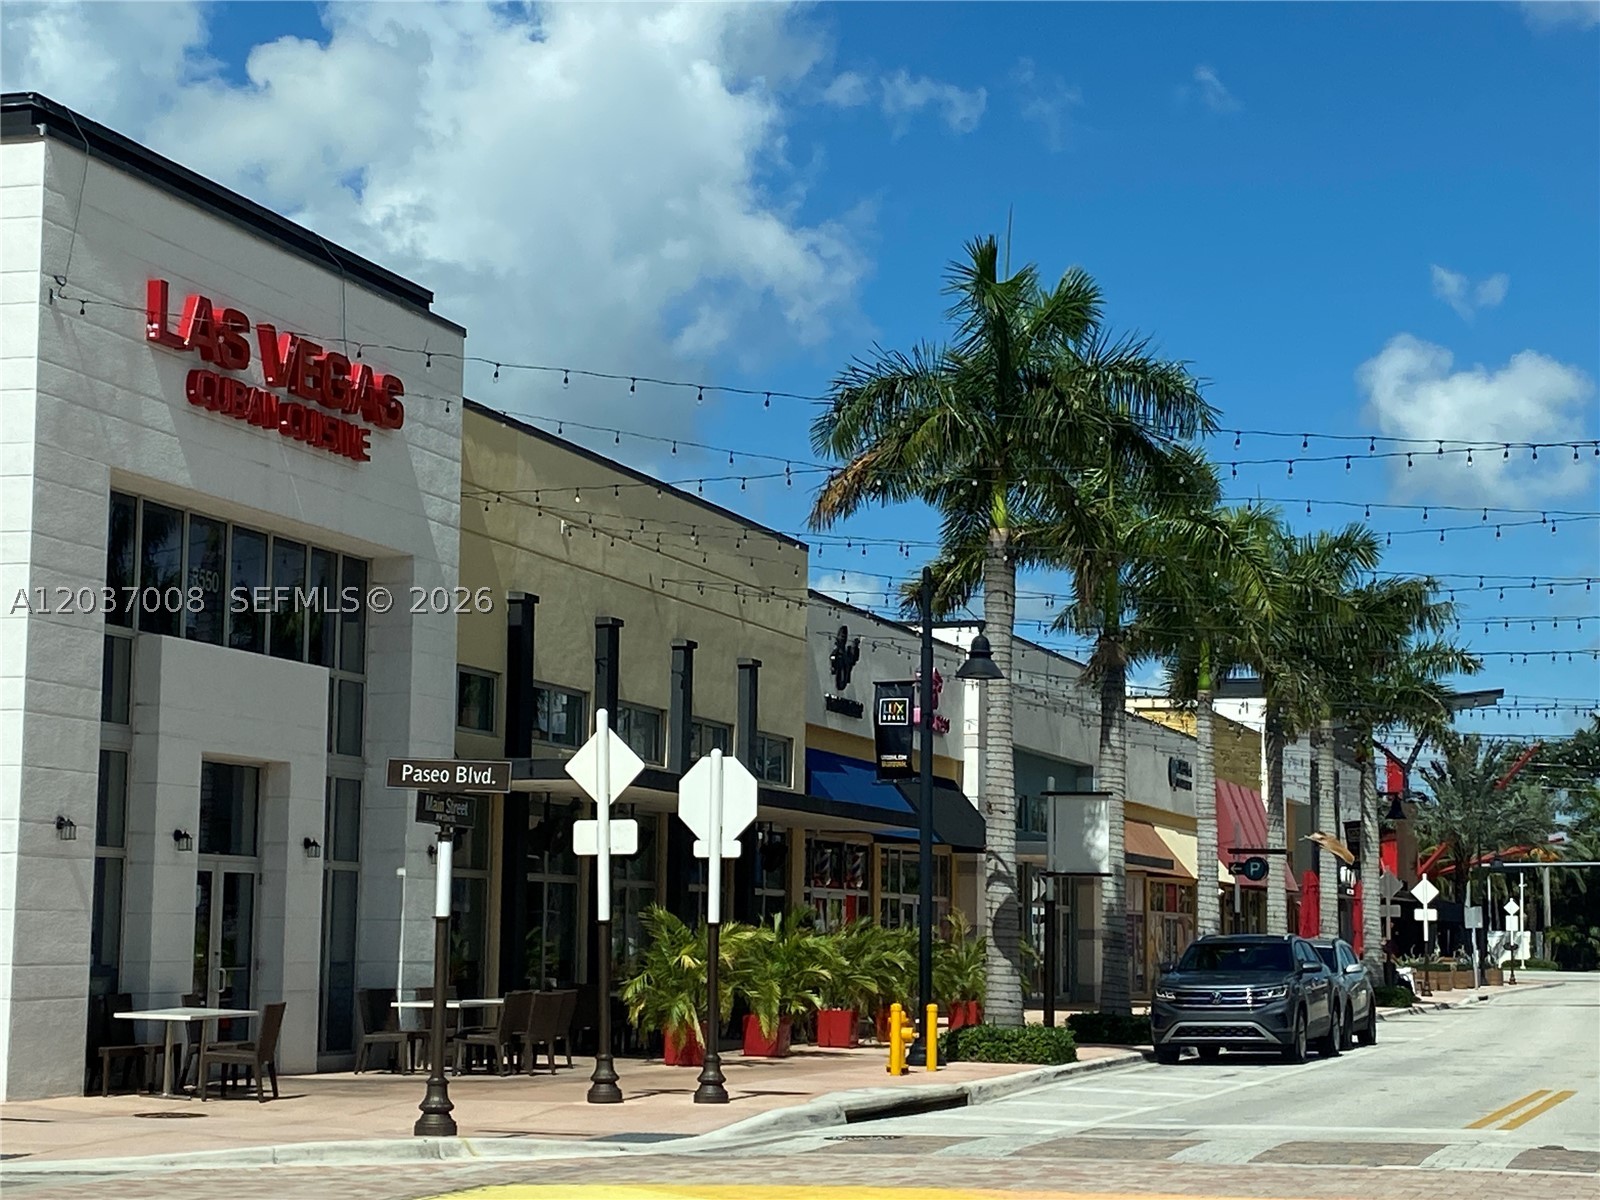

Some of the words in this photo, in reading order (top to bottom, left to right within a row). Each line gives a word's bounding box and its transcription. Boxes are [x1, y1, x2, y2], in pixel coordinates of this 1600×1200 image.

[147, 279, 250, 370] LAS
[256, 323, 404, 429] VEGAS
[185, 369, 279, 430] CUBAN
[278, 402, 371, 462] CUISINE
[402, 764, 450, 783] Paseo
[455, 766, 496, 785] Blvd.
[425, 795, 445, 812] Main
[446, 797, 468, 816] Street
[1250, 862, 1260, 876] P
